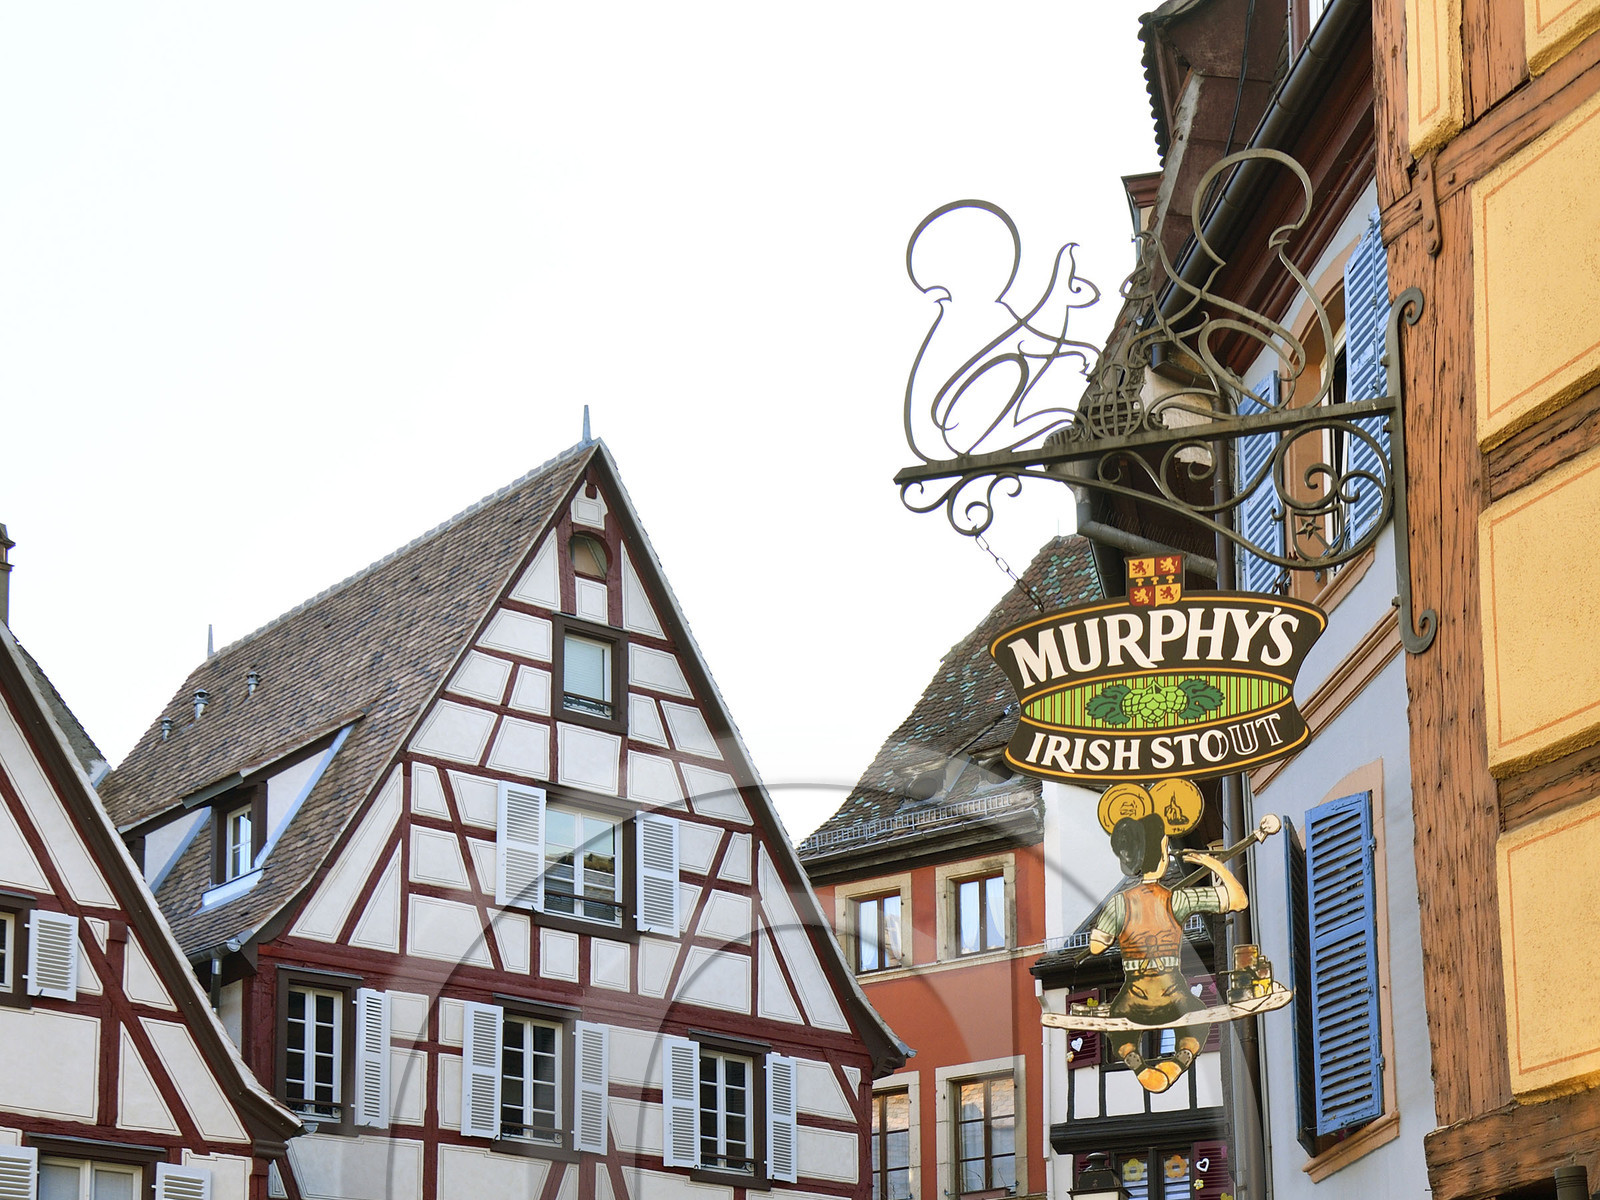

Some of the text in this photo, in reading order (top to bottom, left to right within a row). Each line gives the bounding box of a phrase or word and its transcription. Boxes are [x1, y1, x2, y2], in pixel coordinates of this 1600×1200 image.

[1008, 607, 1299, 689] MURPHY'S
[1025, 713, 1284, 773] IRISH STOUT
